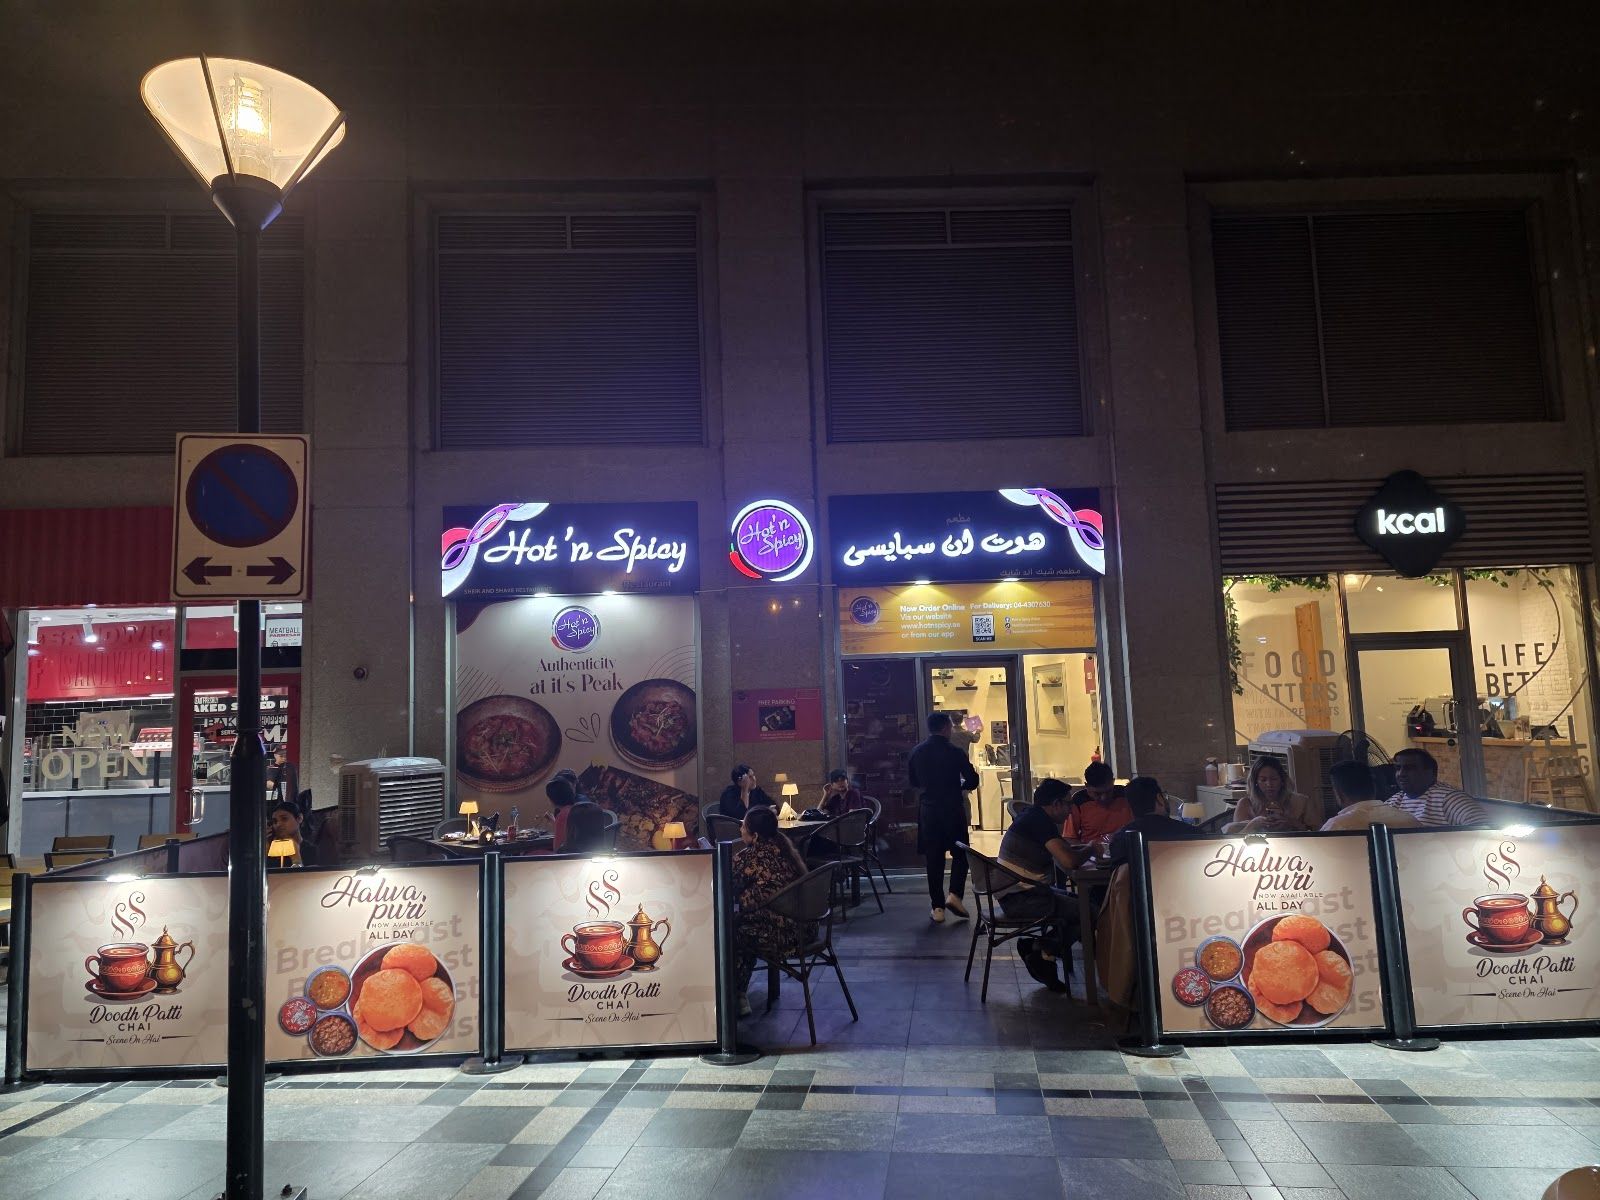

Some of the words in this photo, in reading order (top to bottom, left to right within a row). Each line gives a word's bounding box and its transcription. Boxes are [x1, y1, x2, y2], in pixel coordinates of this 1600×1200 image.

[1377, 507, 1446, 535] kcal
[483, 527, 558, 566] Hot
[595, 527, 687, 574] Spicy
[758, 532, 802, 558] Spicy
[981, 532, 1046, 555] هوت
[919, 604, 940, 612] Order
[942, 603, 966, 611] Online
[983, 601, 1012, 610] Delivery:
[925, 612, 953, 620] website
[566, 626, 595, 640] Spicy
[942, 631, 955, 639] app
[536, 656, 617, 673] Authenticity
[1241, 649, 1336, 680] FOOD
[529, 678, 546, 695] at
[550, 675, 576, 694] it's
[581, 672, 624, 693] Peak
[61, 722, 135, 748] NOW
[41, 749, 148, 781] OPEN
[1203, 843, 1309, 878] Halwa
[320, 875, 422, 908] Halwa
[1252, 866, 1316, 900] puri
[366, 895, 427, 930] puri
[1256, 901, 1278, 911] ALL
[1281, 900, 1304, 910] DAY
[392, 920, 435, 928] AVAILABLE
[368, 931, 390, 940] ALL
[392, 929, 415, 939] DAY
[1476, 957, 1531, 978] Doodh
[1532, 955, 1576, 975] Patti
[1508, 975, 1544, 985] CHAI
[567, 983, 619, 1003] Doodh
[620, 981, 661, 1000] Patti
[1498, 988, 1522, 1000] Scene
[1522, 987, 1535, 998] On
[1536, 987, 1557, 998] Hai
[89, 1004, 140, 1024] Doodh
[142, 1003, 183, 1022] Patti
[596, 1000, 630, 1010] CHAI
[118, 1022, 152, 1032] CHAI
[584, 1013, 606, 1024] Scene
[608, 1013, 620, 1023] On
[620, 1011, 640, 1023] Hai
[105, 1034, 129, 1046] Scene
[128, 1034, 141, 1044] On
[141, 1033, 161, 1044] Hai
